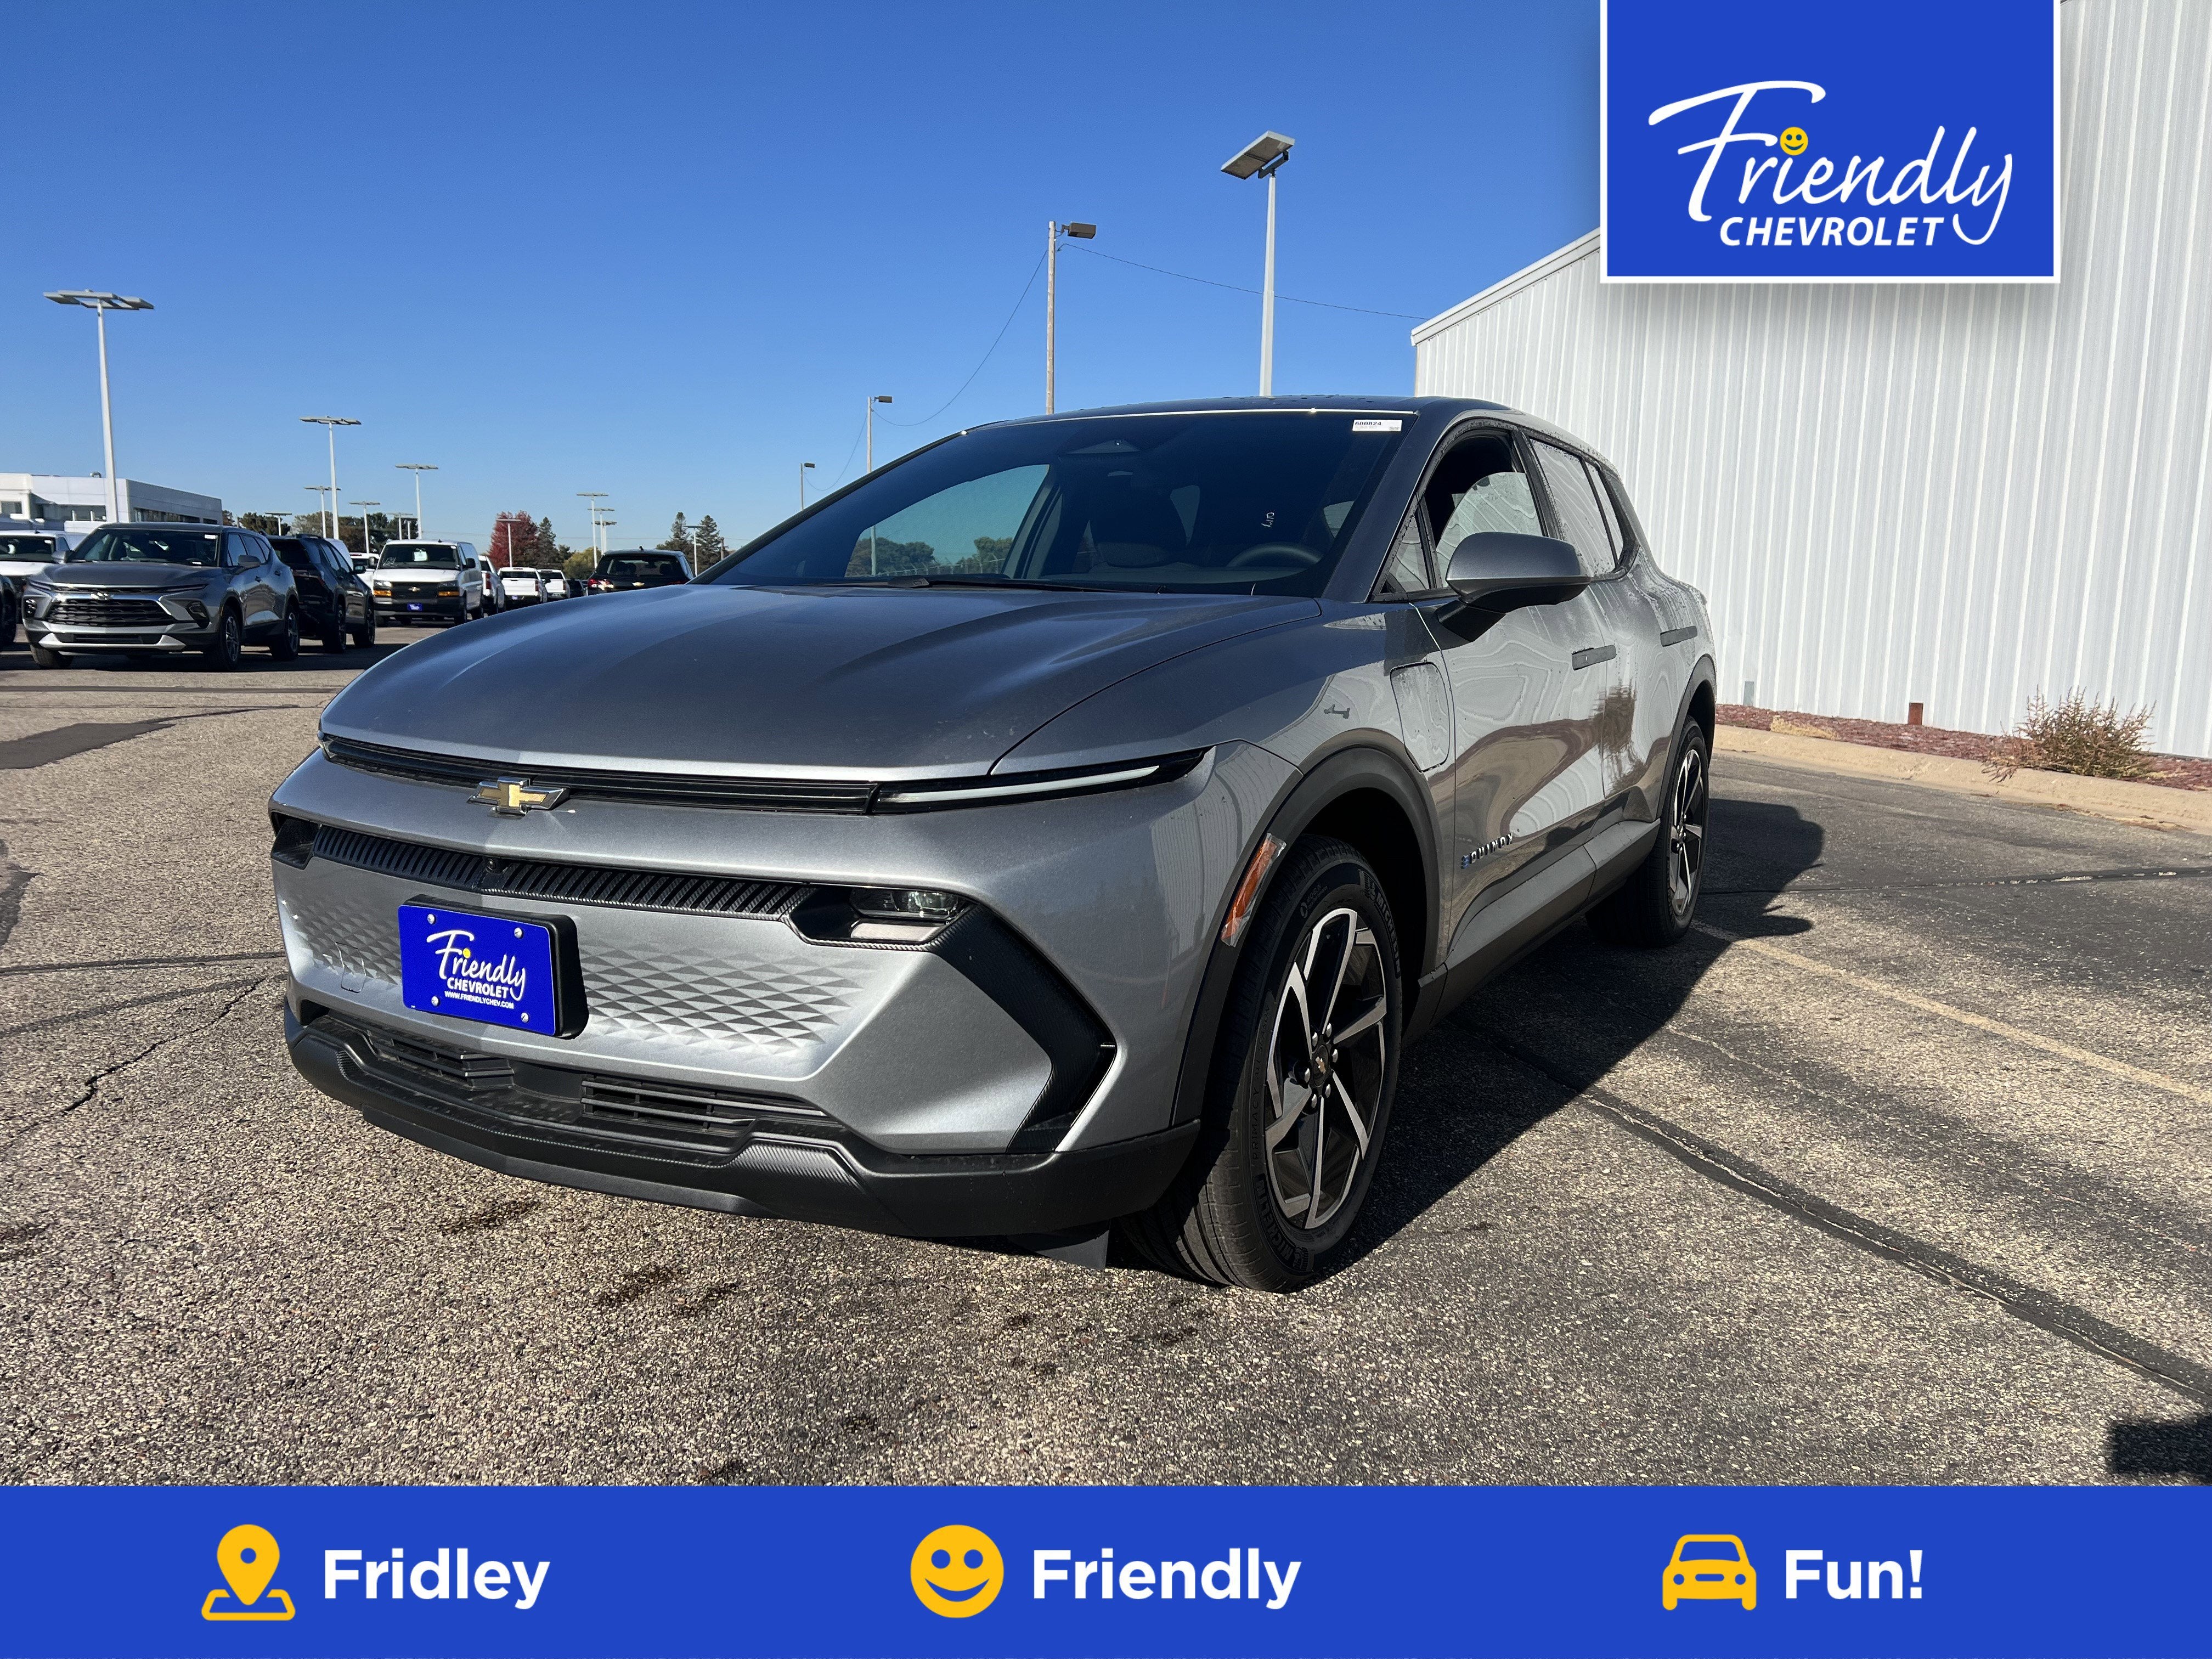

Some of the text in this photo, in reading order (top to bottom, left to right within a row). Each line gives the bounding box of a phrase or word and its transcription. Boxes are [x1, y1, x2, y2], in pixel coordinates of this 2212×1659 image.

[426, 930, 527, 1001] Friendly
[444, 990, 515, 1009] WWW.FRIENDLYCHEV.COM
[447, 977, 509, 999] CHEVROLET
[1251, 1087, 1260, 1160] PRIMACY
[1255, 1180, 1294, 1261] MICHELIN
